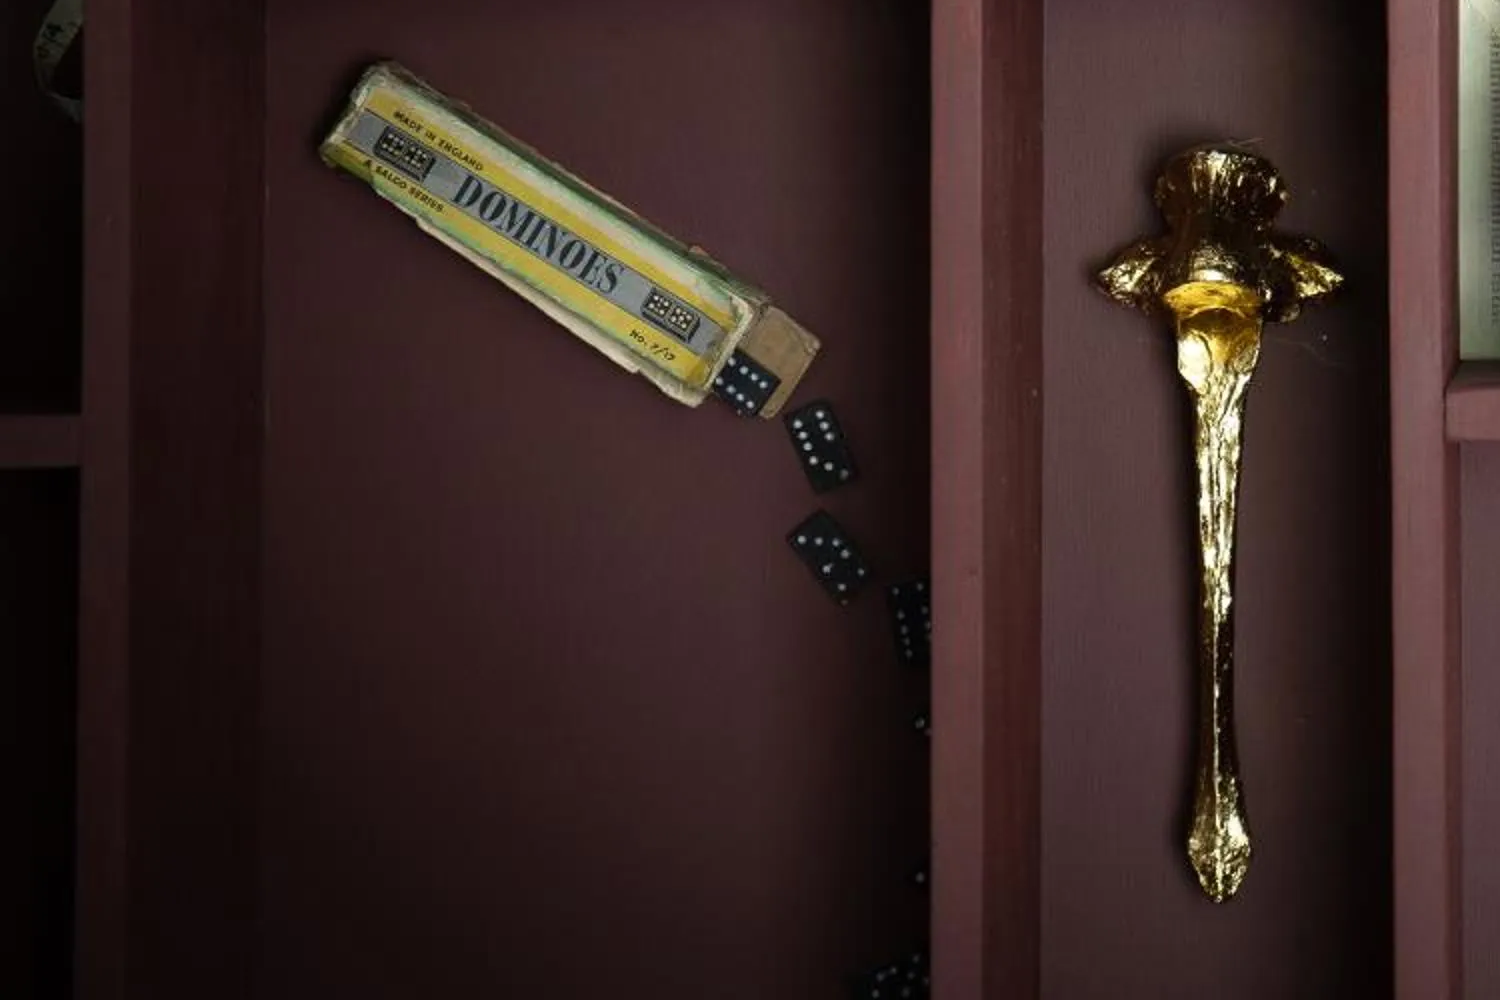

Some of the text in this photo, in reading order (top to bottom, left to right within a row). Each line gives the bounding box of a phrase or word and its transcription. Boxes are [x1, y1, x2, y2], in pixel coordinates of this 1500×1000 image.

[393, 110, 424, 132] MADE
[438, 139, 484, 171] ENGLAND
[452, 174, 625, 294] DOMINOES
